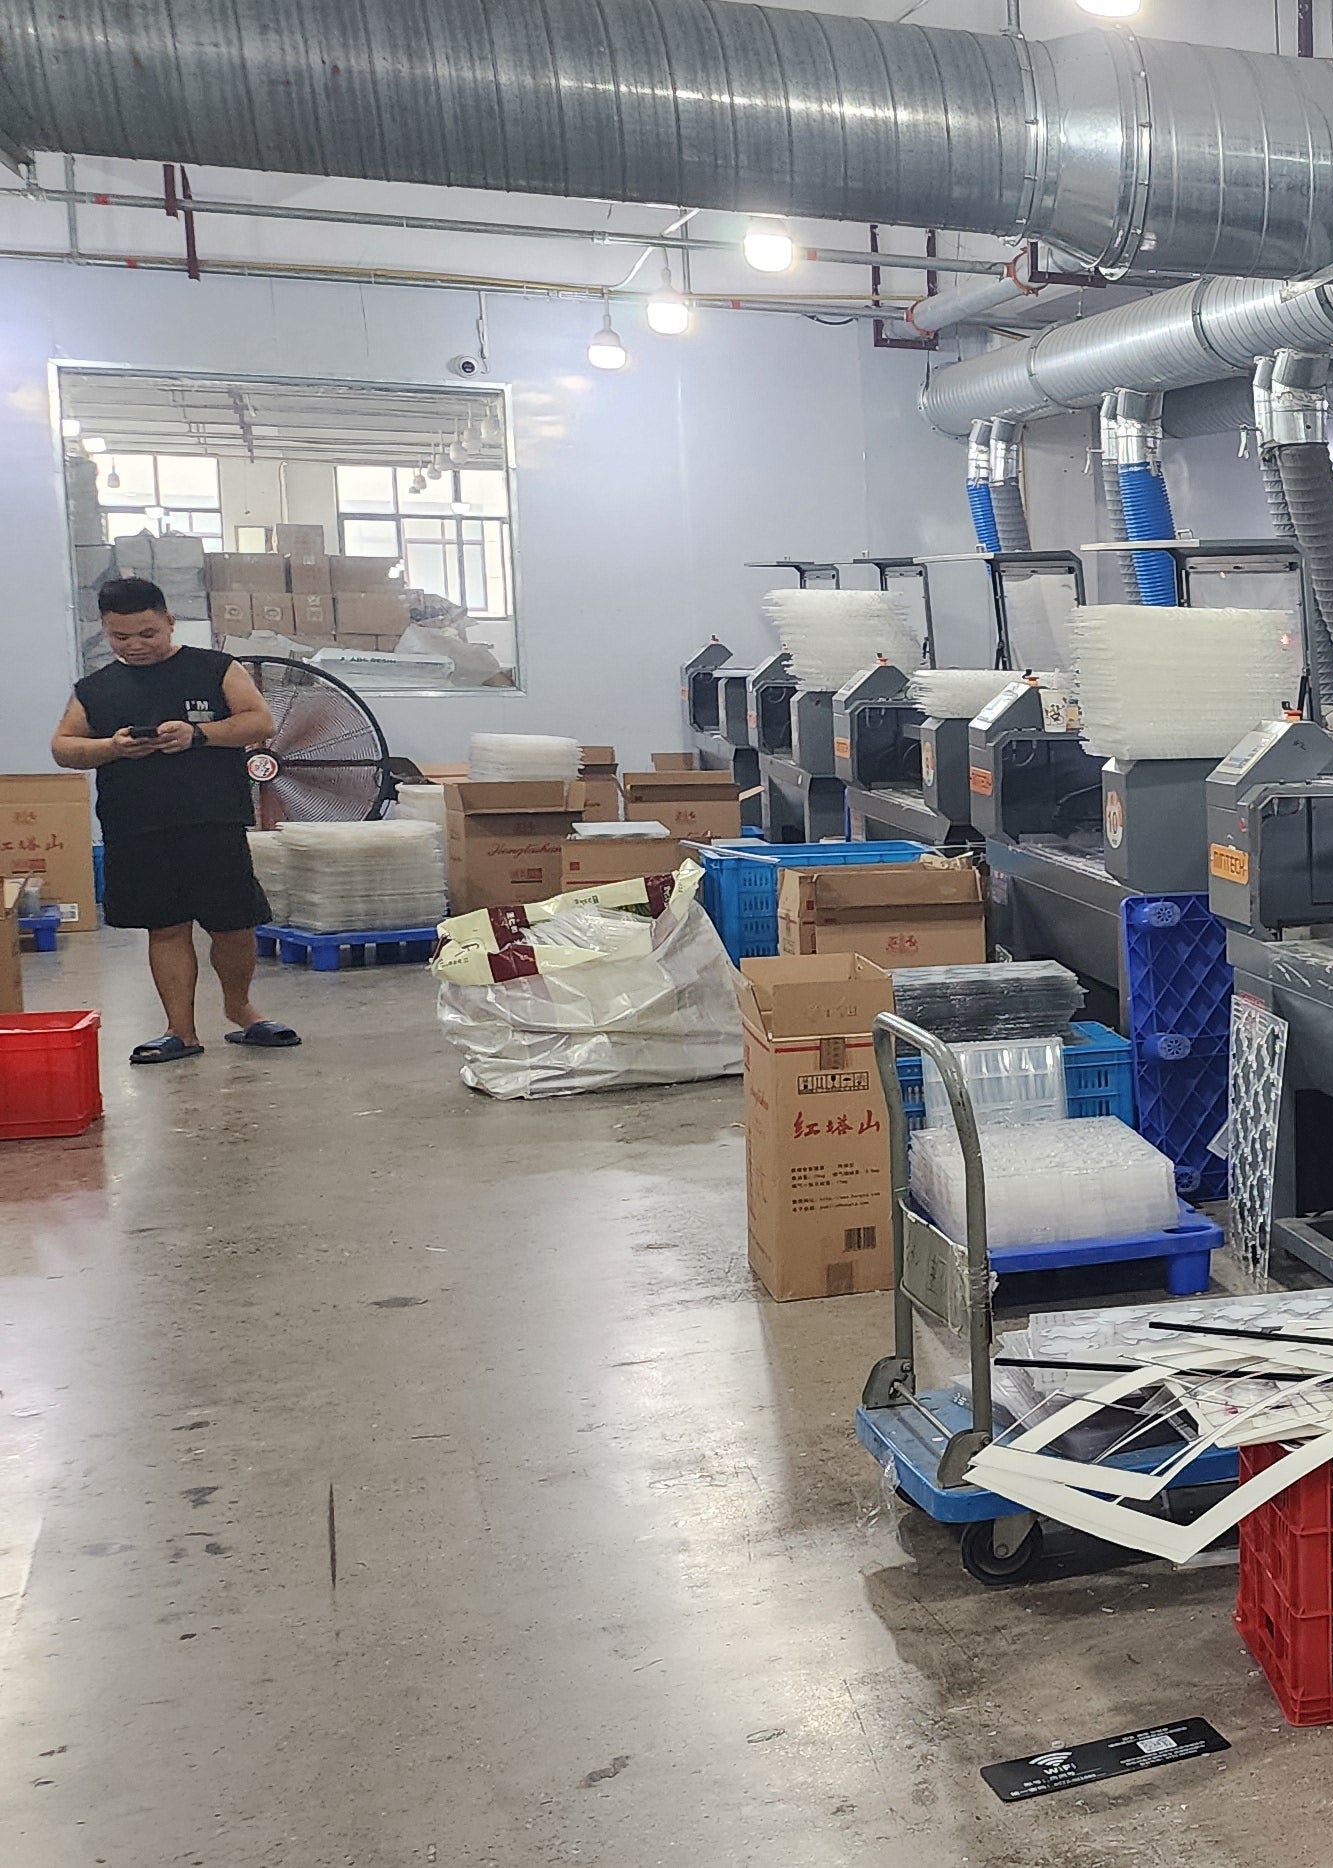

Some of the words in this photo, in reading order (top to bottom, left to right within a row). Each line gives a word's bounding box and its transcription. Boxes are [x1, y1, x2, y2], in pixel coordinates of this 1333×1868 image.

[1108, 811, 1118, 835] 10
[793, 1109, 881, 1139] 红塔山
